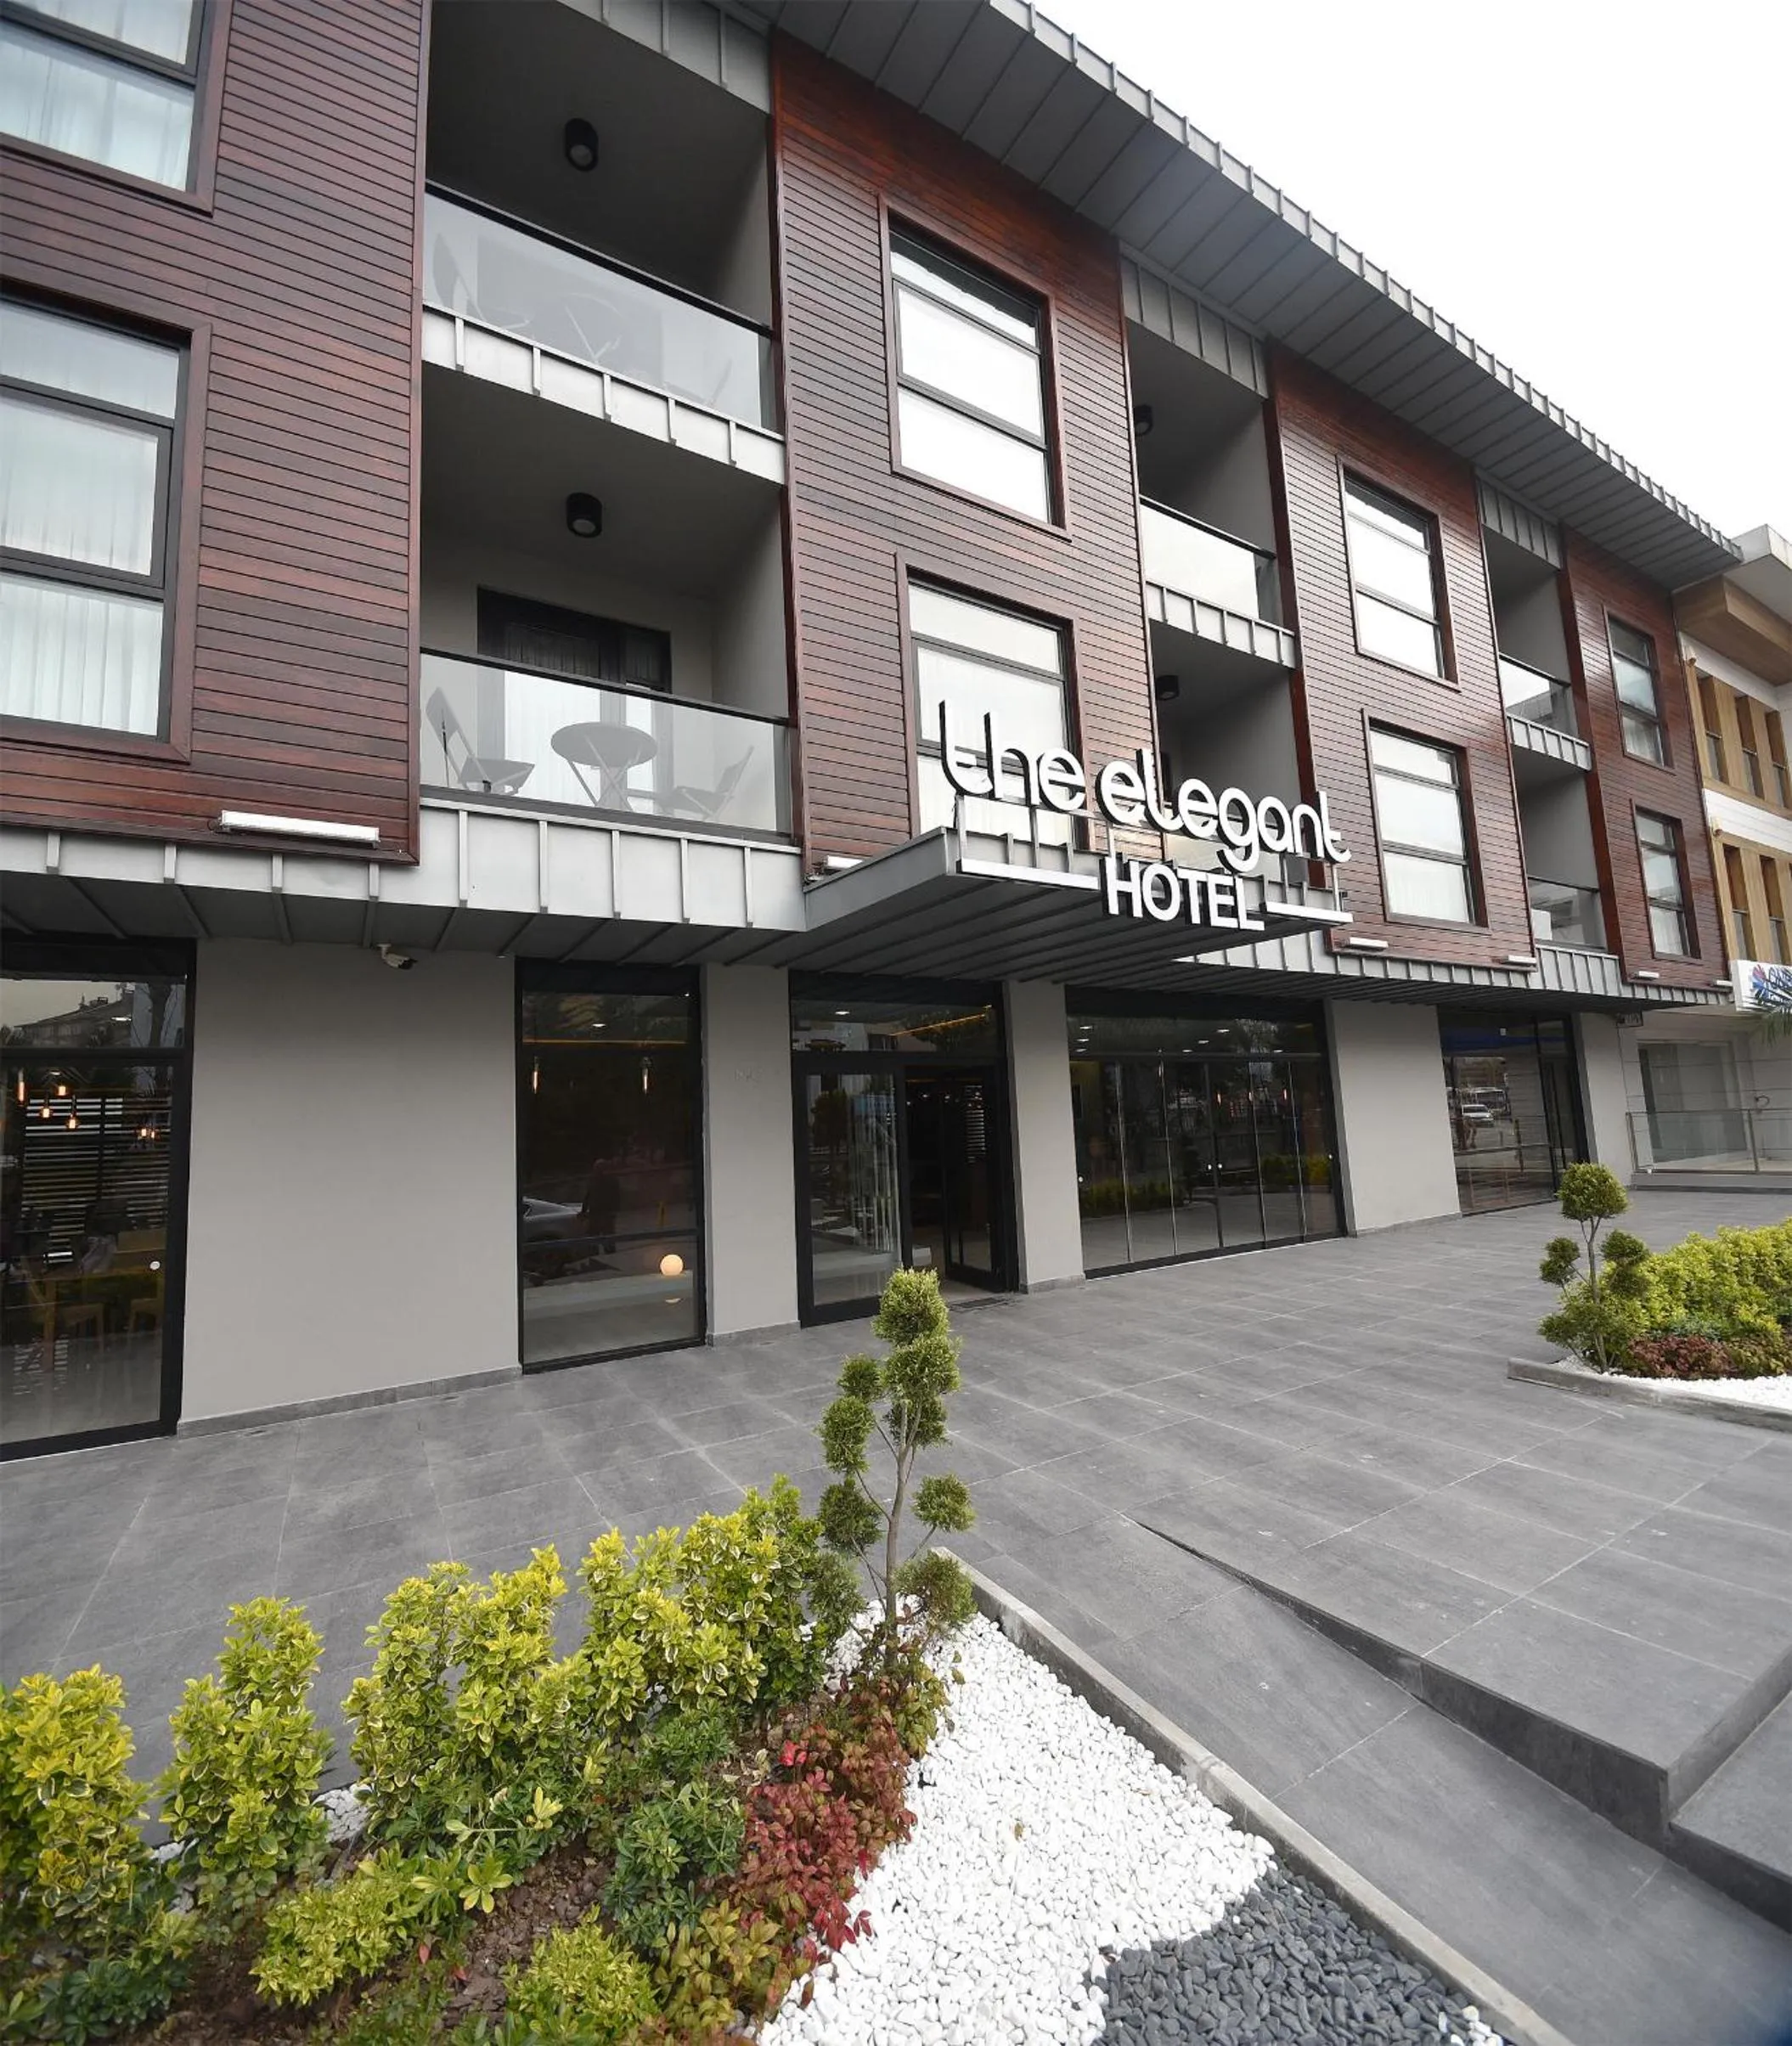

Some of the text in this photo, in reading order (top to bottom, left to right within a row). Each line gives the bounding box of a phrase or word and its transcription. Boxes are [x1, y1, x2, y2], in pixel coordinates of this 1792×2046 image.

[938, 700, 1352, 873] the elegant
[1104, 854, 1265, 931] HOTEL
